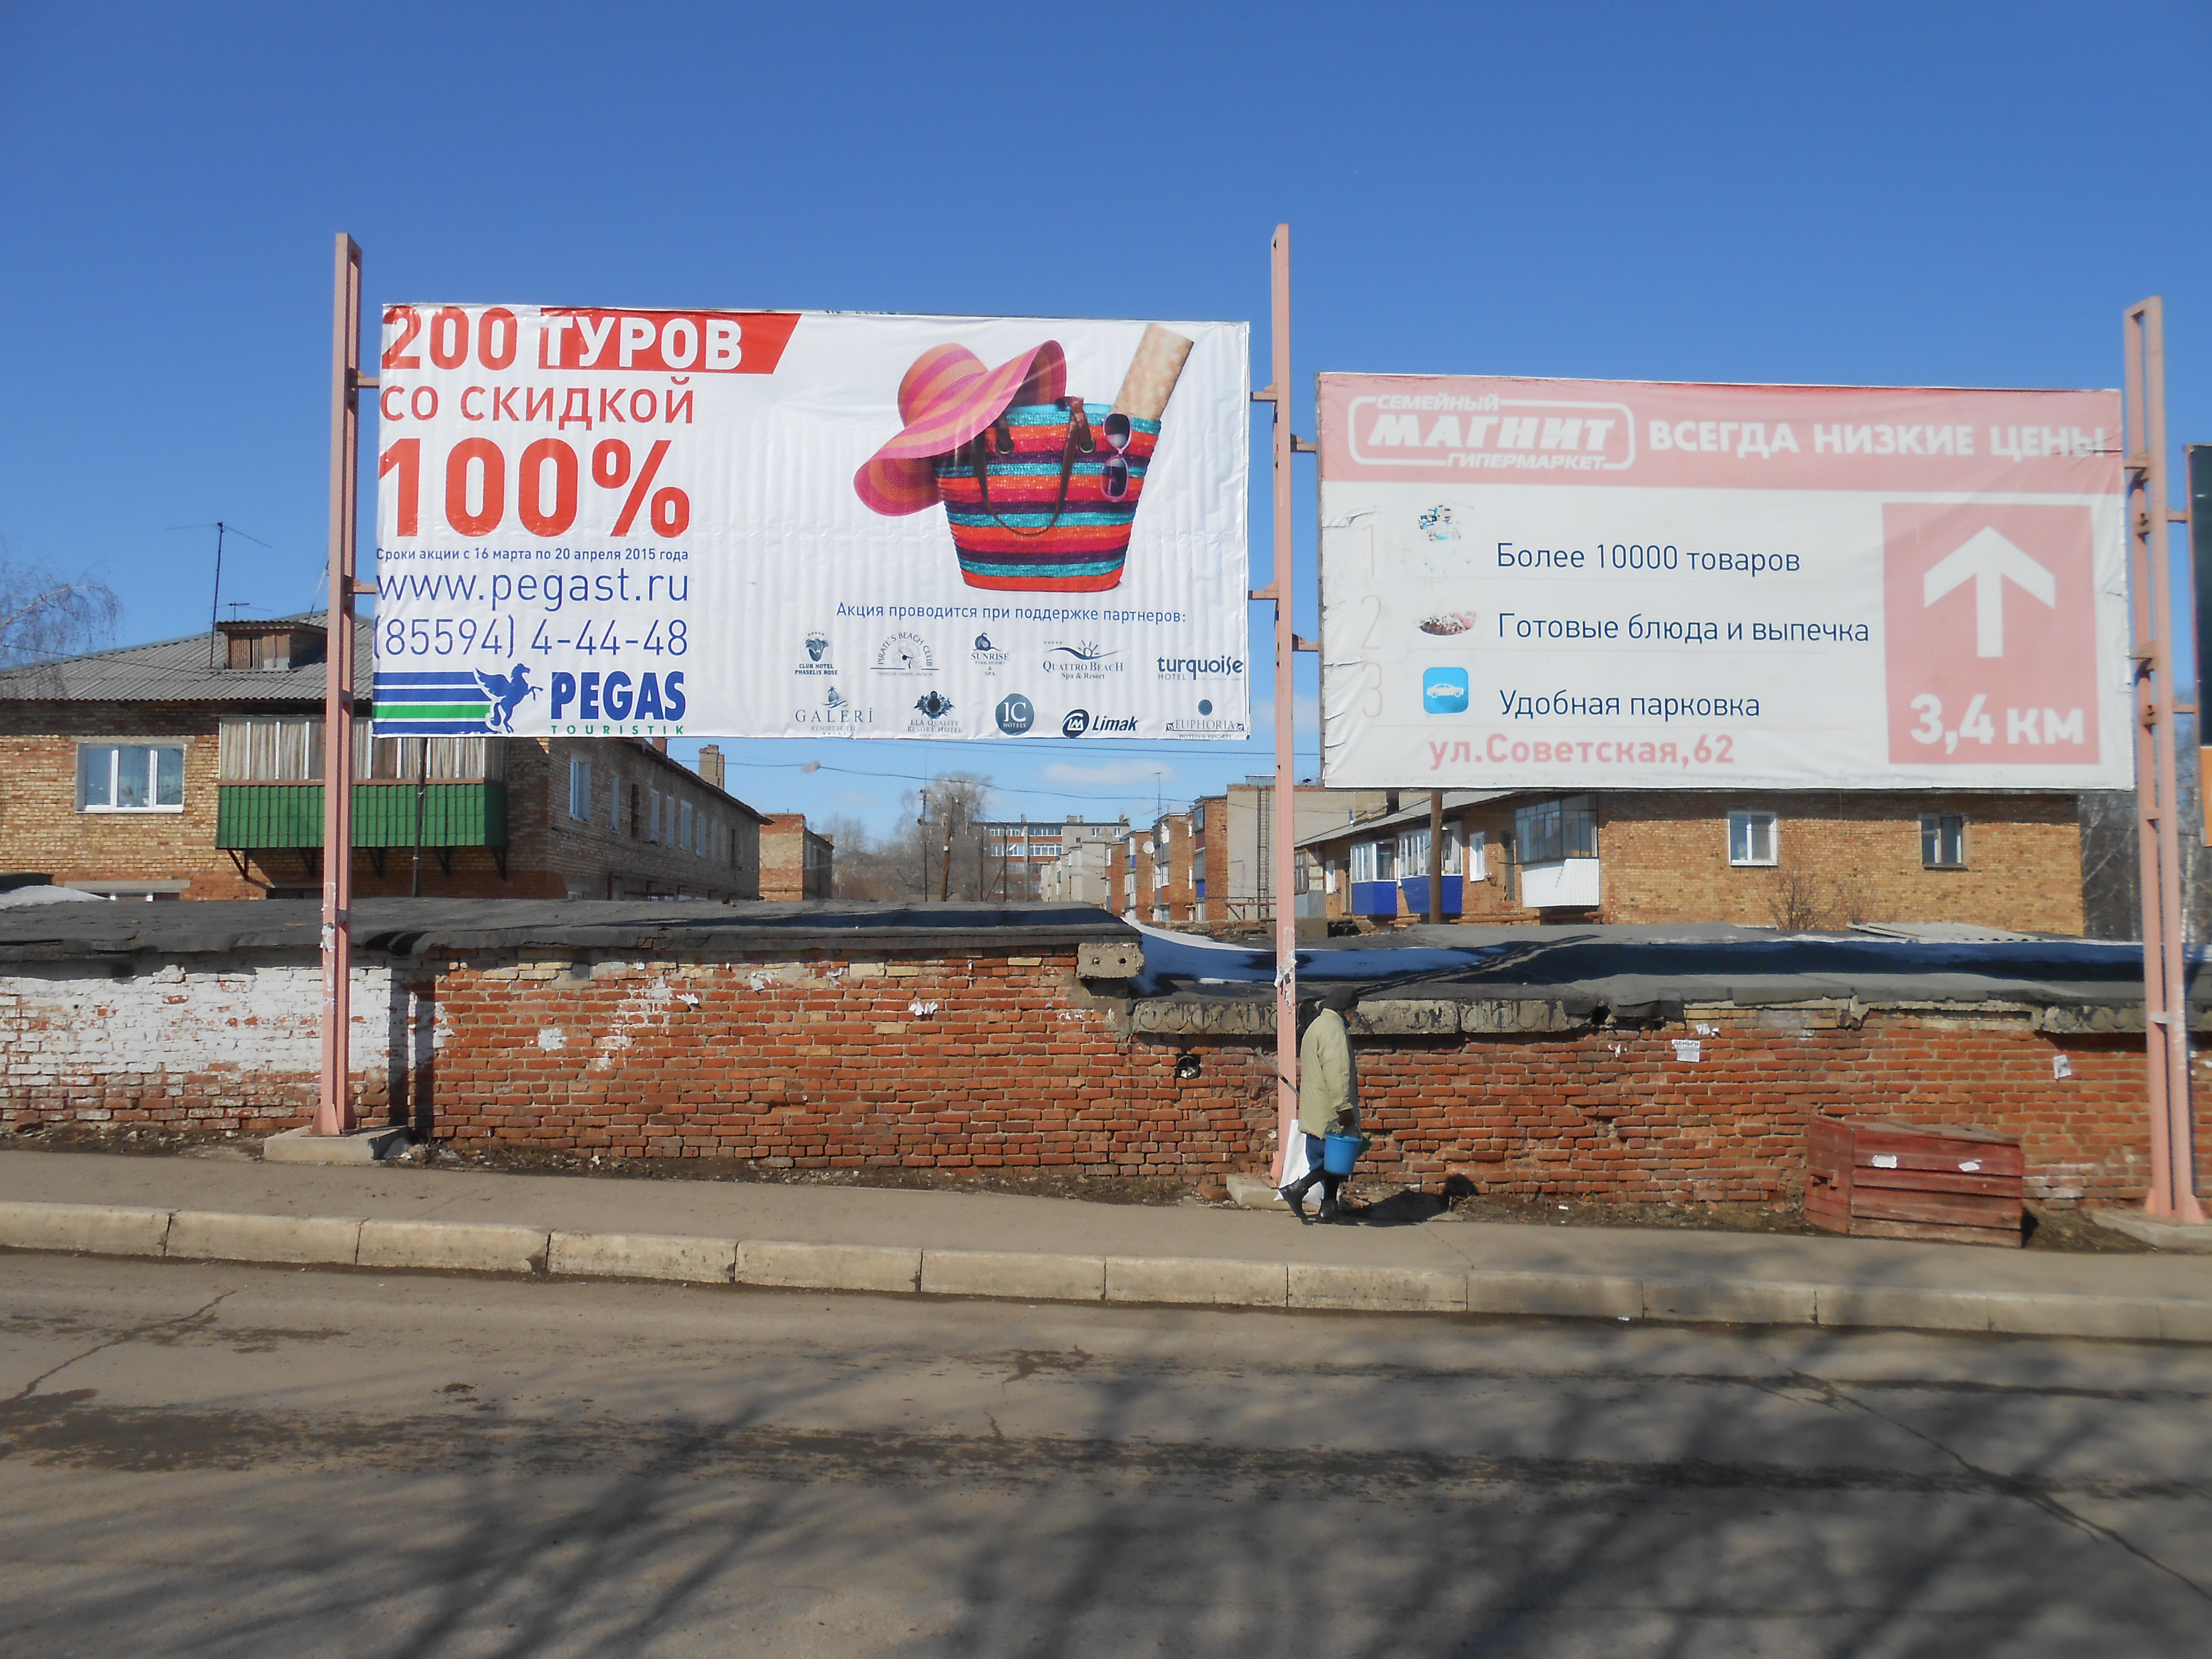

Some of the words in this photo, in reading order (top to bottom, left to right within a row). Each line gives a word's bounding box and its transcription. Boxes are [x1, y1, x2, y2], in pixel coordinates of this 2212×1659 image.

[381, 305, 518, 371] 200
[540, 315, 742, 370] ТУРОВ
[1376, 392, 1500, 412] СЕМЕЙНЫЙ
[1367, 415, 1615, 450] МАГНИТ
[1649, 420, 1799, 458] ВСЕГДА
[1814, 424, 1979, 455] НИЗКИЕ
[1991, 426, 2105, 462] ЦЕНЫ
[1447, 453, 1606, 470] ГИПЕРМАРКЕТ
[380, 437, 690, 538] 100%
[376, 548, 415, 562] Сроки
[420, 550, 459, 561] акции
[463, 550, 469, 559] с
[475, 547, 489, 559] 16
[493, 551, 531, 562] марта
[536, 551, 551, 559] по
[555, 548, 570, 560] 20
[574, 551, 621, 563] апреля
[625, 548, 655, 560] 2015
[660, 551, 688, 562] года
[1498, 542, 1585, 568] Более
[1598, 544, 1677, 570] 10000
[1686, 552, 1800, 578] товаров
[376, 567, 688, 612] www.pegast.ru
[837, 602, 883, 618] Акция
[889, 606, 977, 620] проводится
[983, 608, 1010, 622] при
[1015, 608, 1098, 623] поддержке
[1104, 610, 1185, 625] партнеров:
[1499, 613, 1618, 639] Готовые
[1629, 613, 1718, 644] блюда
[1728, 623, 1743, 640] и
[1753, 623, 1869, 642] выпечка
[373, 615, 514, 660] (85594)
[531, 619, 687, 656] 4-44-48
[898, 632, 924, 645] BEACH
[923, 645, 932, 667] CLUB
[1043, 661, 1088, 673] QUATTRO
[1090, 662, 1123, 671] BEACH
[551, 671, 686, 721] PEGAS
[1004, 702, 1026, 722] IC
[1500, 689, 1620, 719] Удобная
[1631, 697, 1760, 722] парковка
[551, 725, 684, 735] TOURISTIK
[1092, 715, 1138, 731] Limak
[1176, 720, 1235, 730] EUPHORIA
[1910, 693, 1995, 754] 3,4
